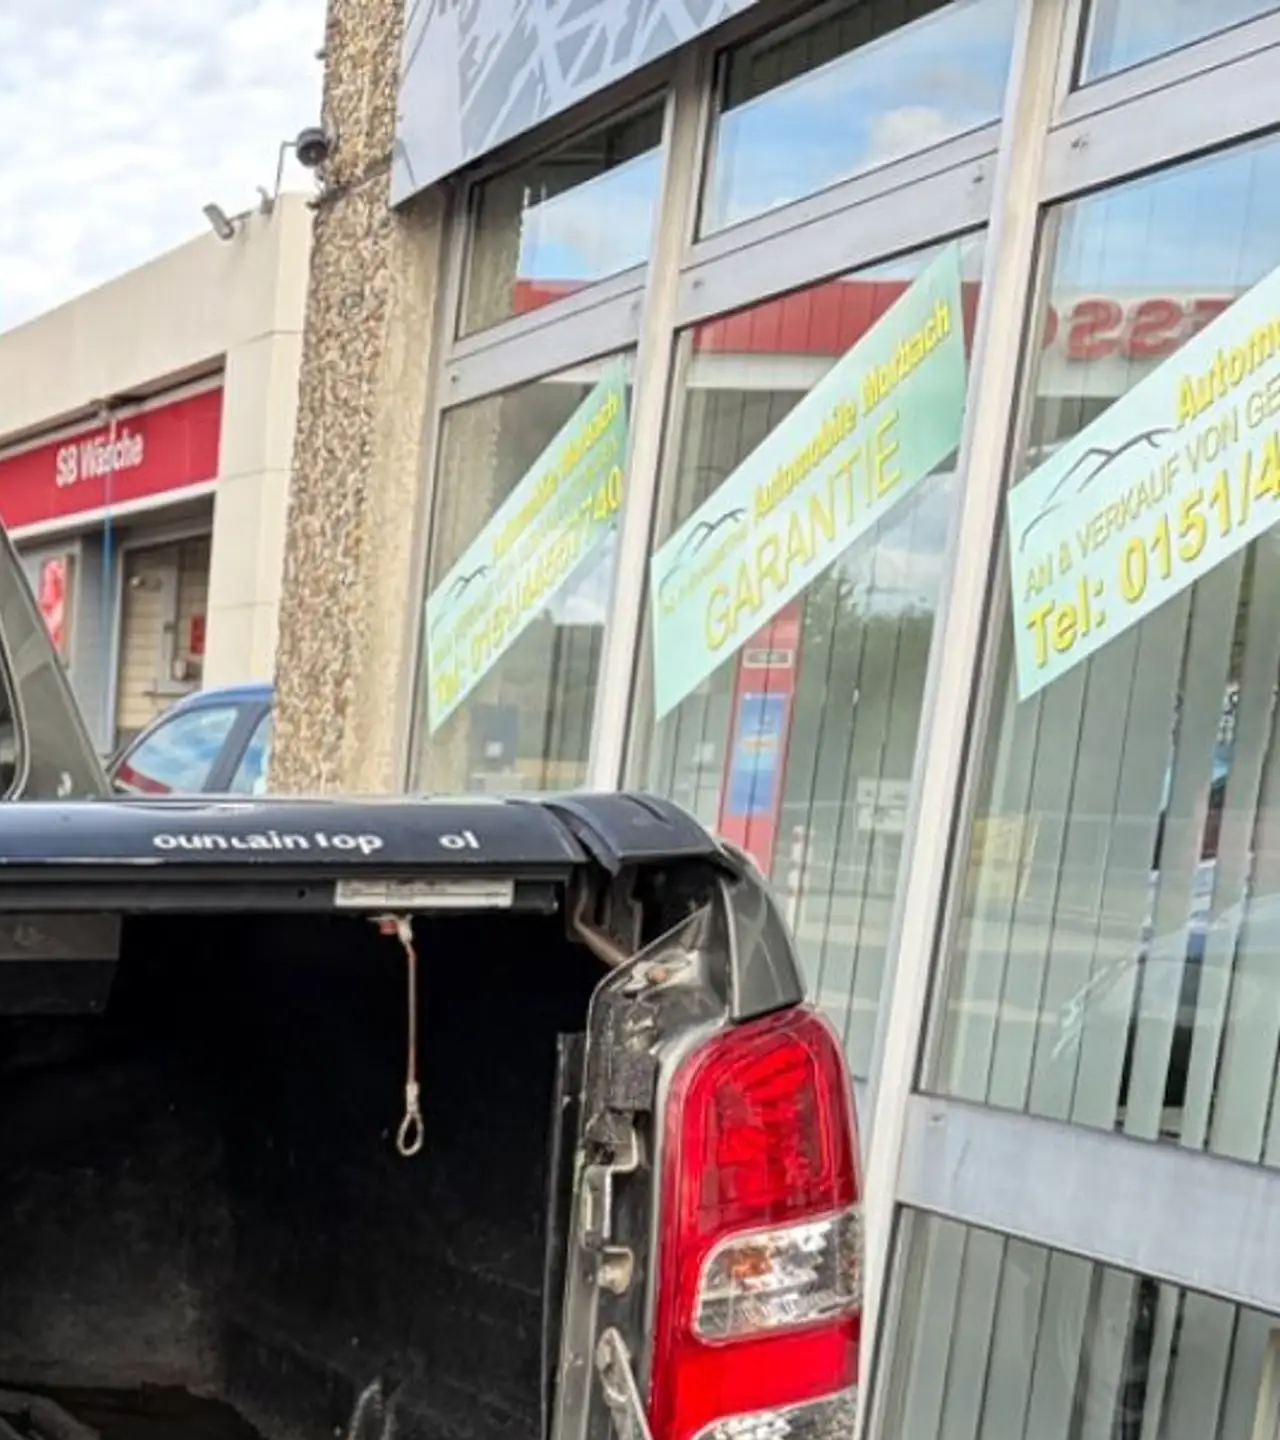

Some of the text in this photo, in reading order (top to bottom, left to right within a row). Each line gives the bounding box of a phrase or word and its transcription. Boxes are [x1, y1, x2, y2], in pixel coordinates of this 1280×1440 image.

[1177, 320, 1280, 430] Autom
[55, 444, 78, 488] SB
[704, 407, 903, 652] GARANTIE
[1026, 574, 1107, 669] Tel:
